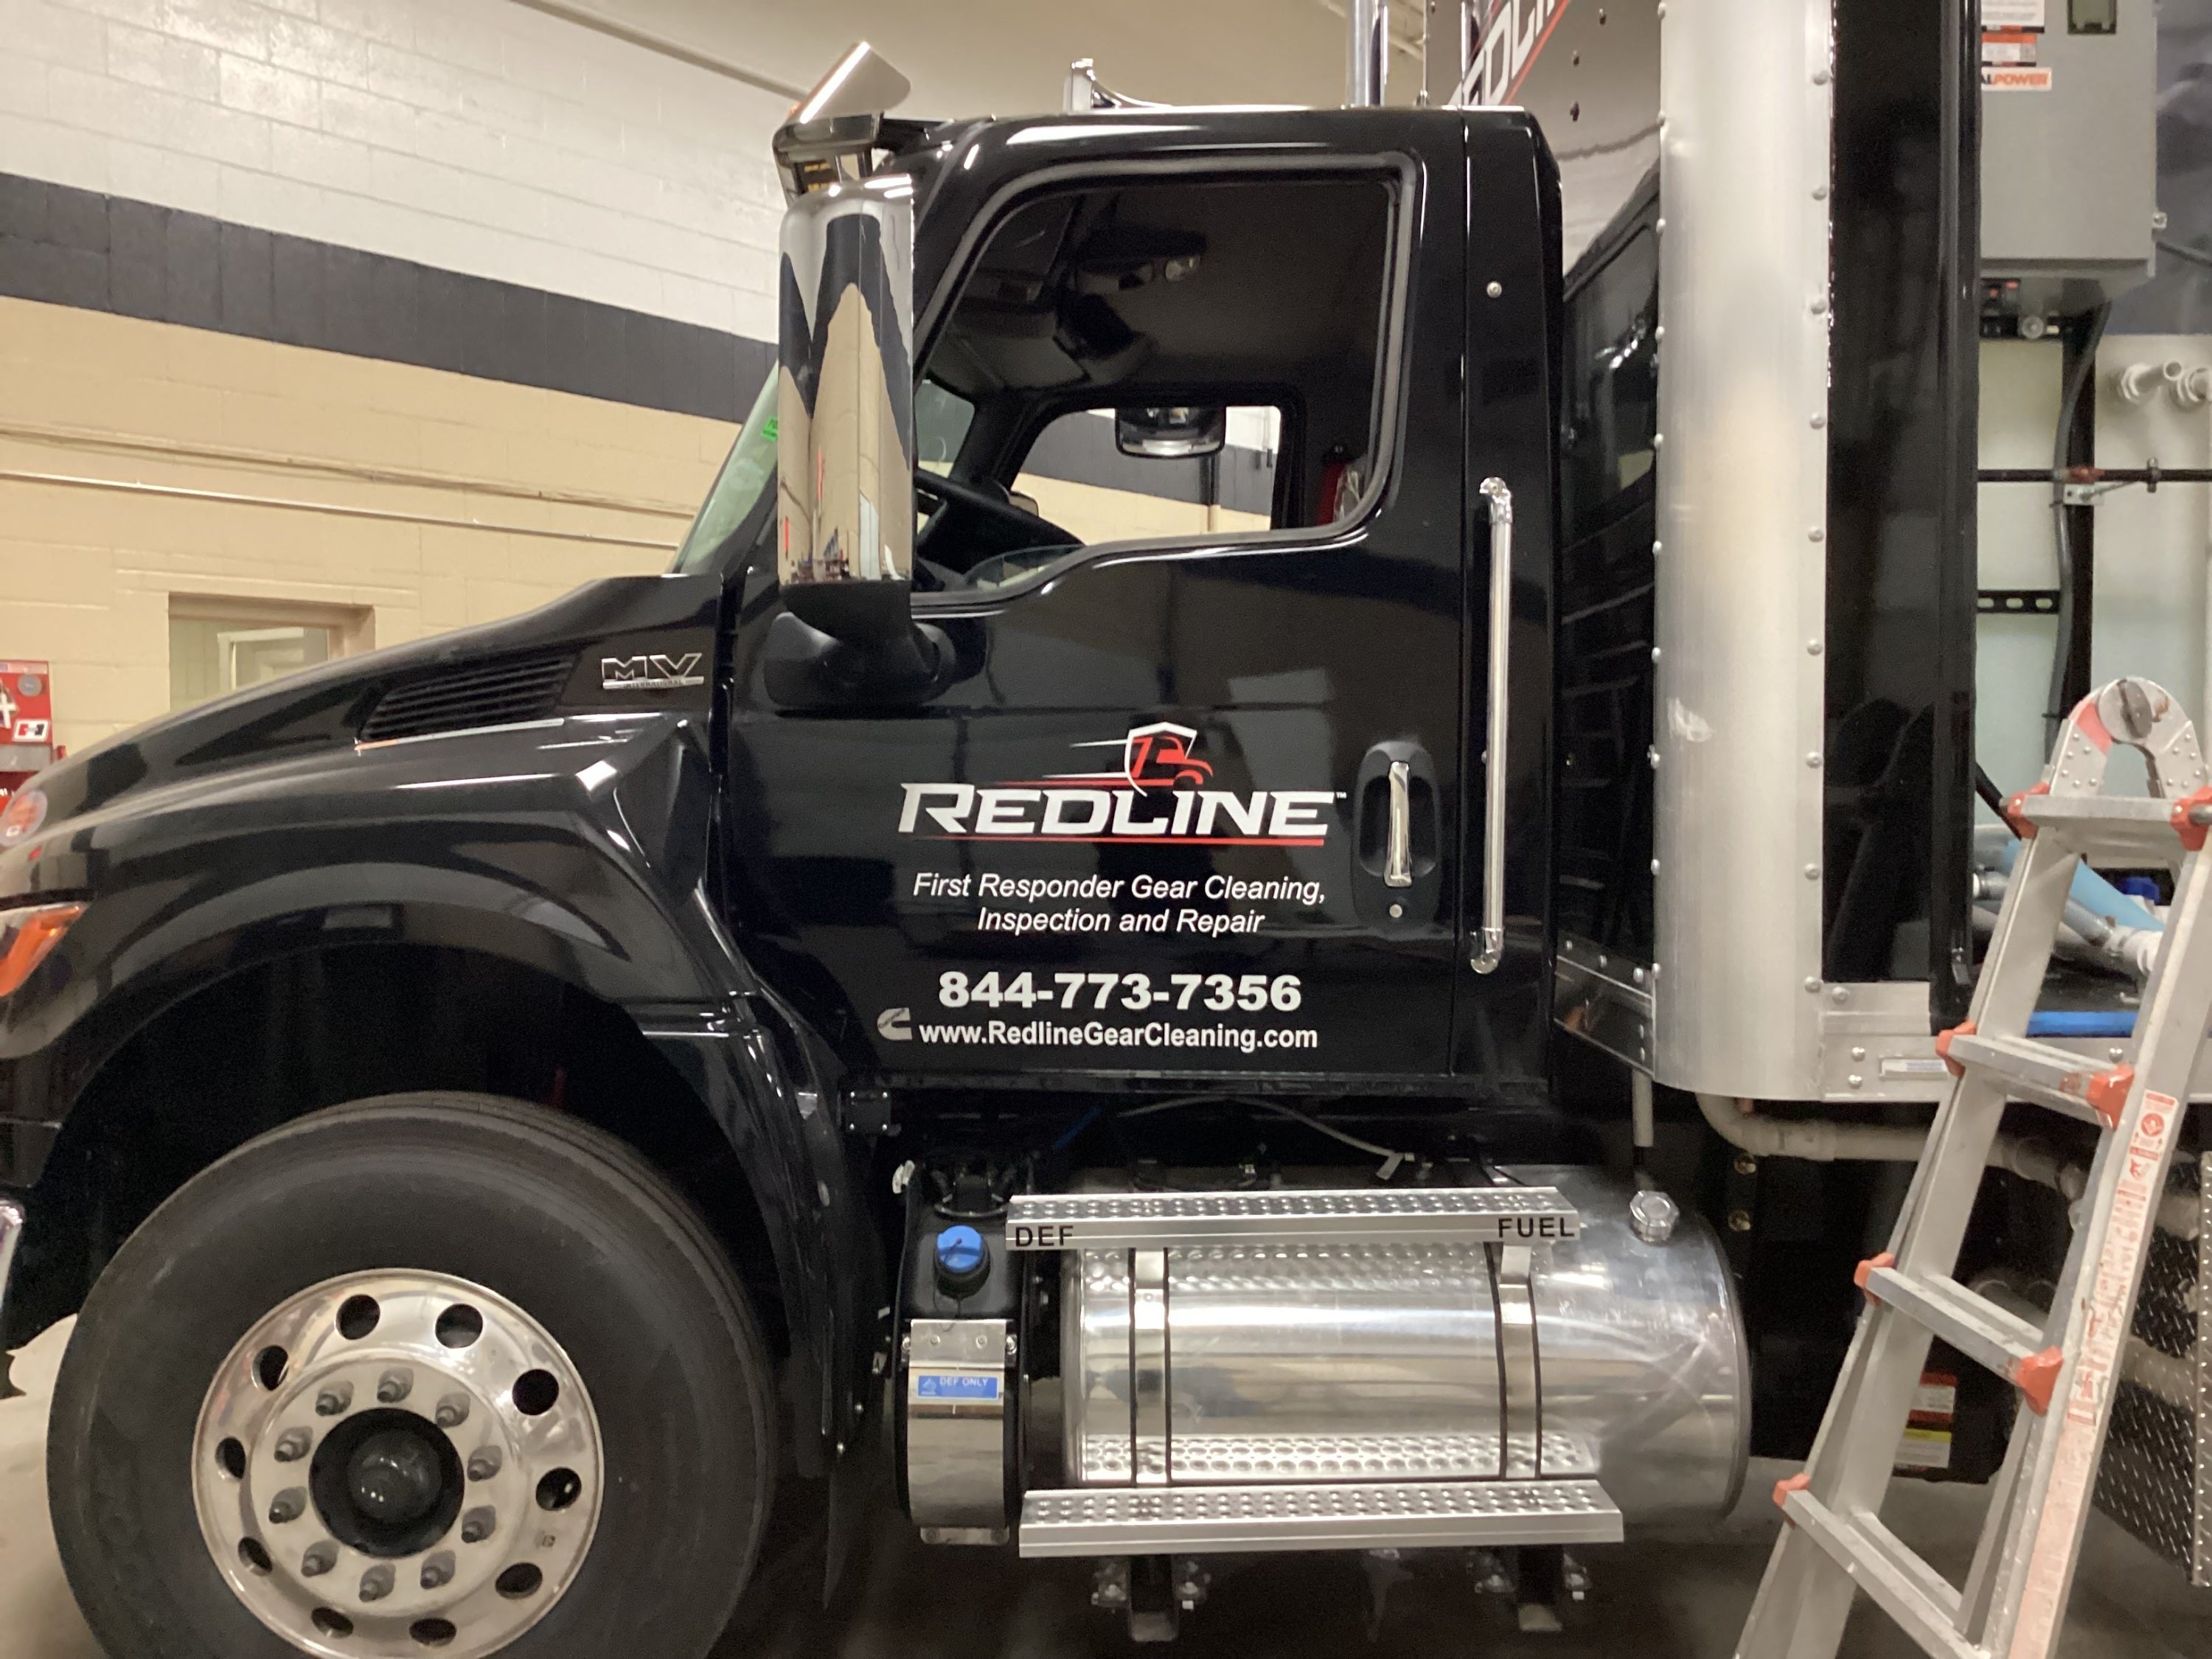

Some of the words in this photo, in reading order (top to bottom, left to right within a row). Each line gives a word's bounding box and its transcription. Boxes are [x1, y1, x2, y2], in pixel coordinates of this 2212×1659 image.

[601, 653, 702, 680] MV
[898, 783, 1335, 836] REDLINE
[914, 872, 972, 897] First
[978, 873, 1125, 903] Responder
[1131, 874, 1198, 899] Gear
[1204, 875, 1325, 905] Cleaning,
[977, 906, 1111, 936] Inspection
[1119, 908, 1170, 932] and
[1176, 908, 1266, 938] Repair
[939, 971, 1302, 1011] 844-773-7356
[919, 1020, 1318, 1054] www.RedlineGearCleaning.com
[1016, 1225, 1074, 1247] DEF
[1498, 1217, 1575, 1238] FUEL
[939, 1377, 959, 1385] DEF
[962, 1377, 988, 1386] ONLY
